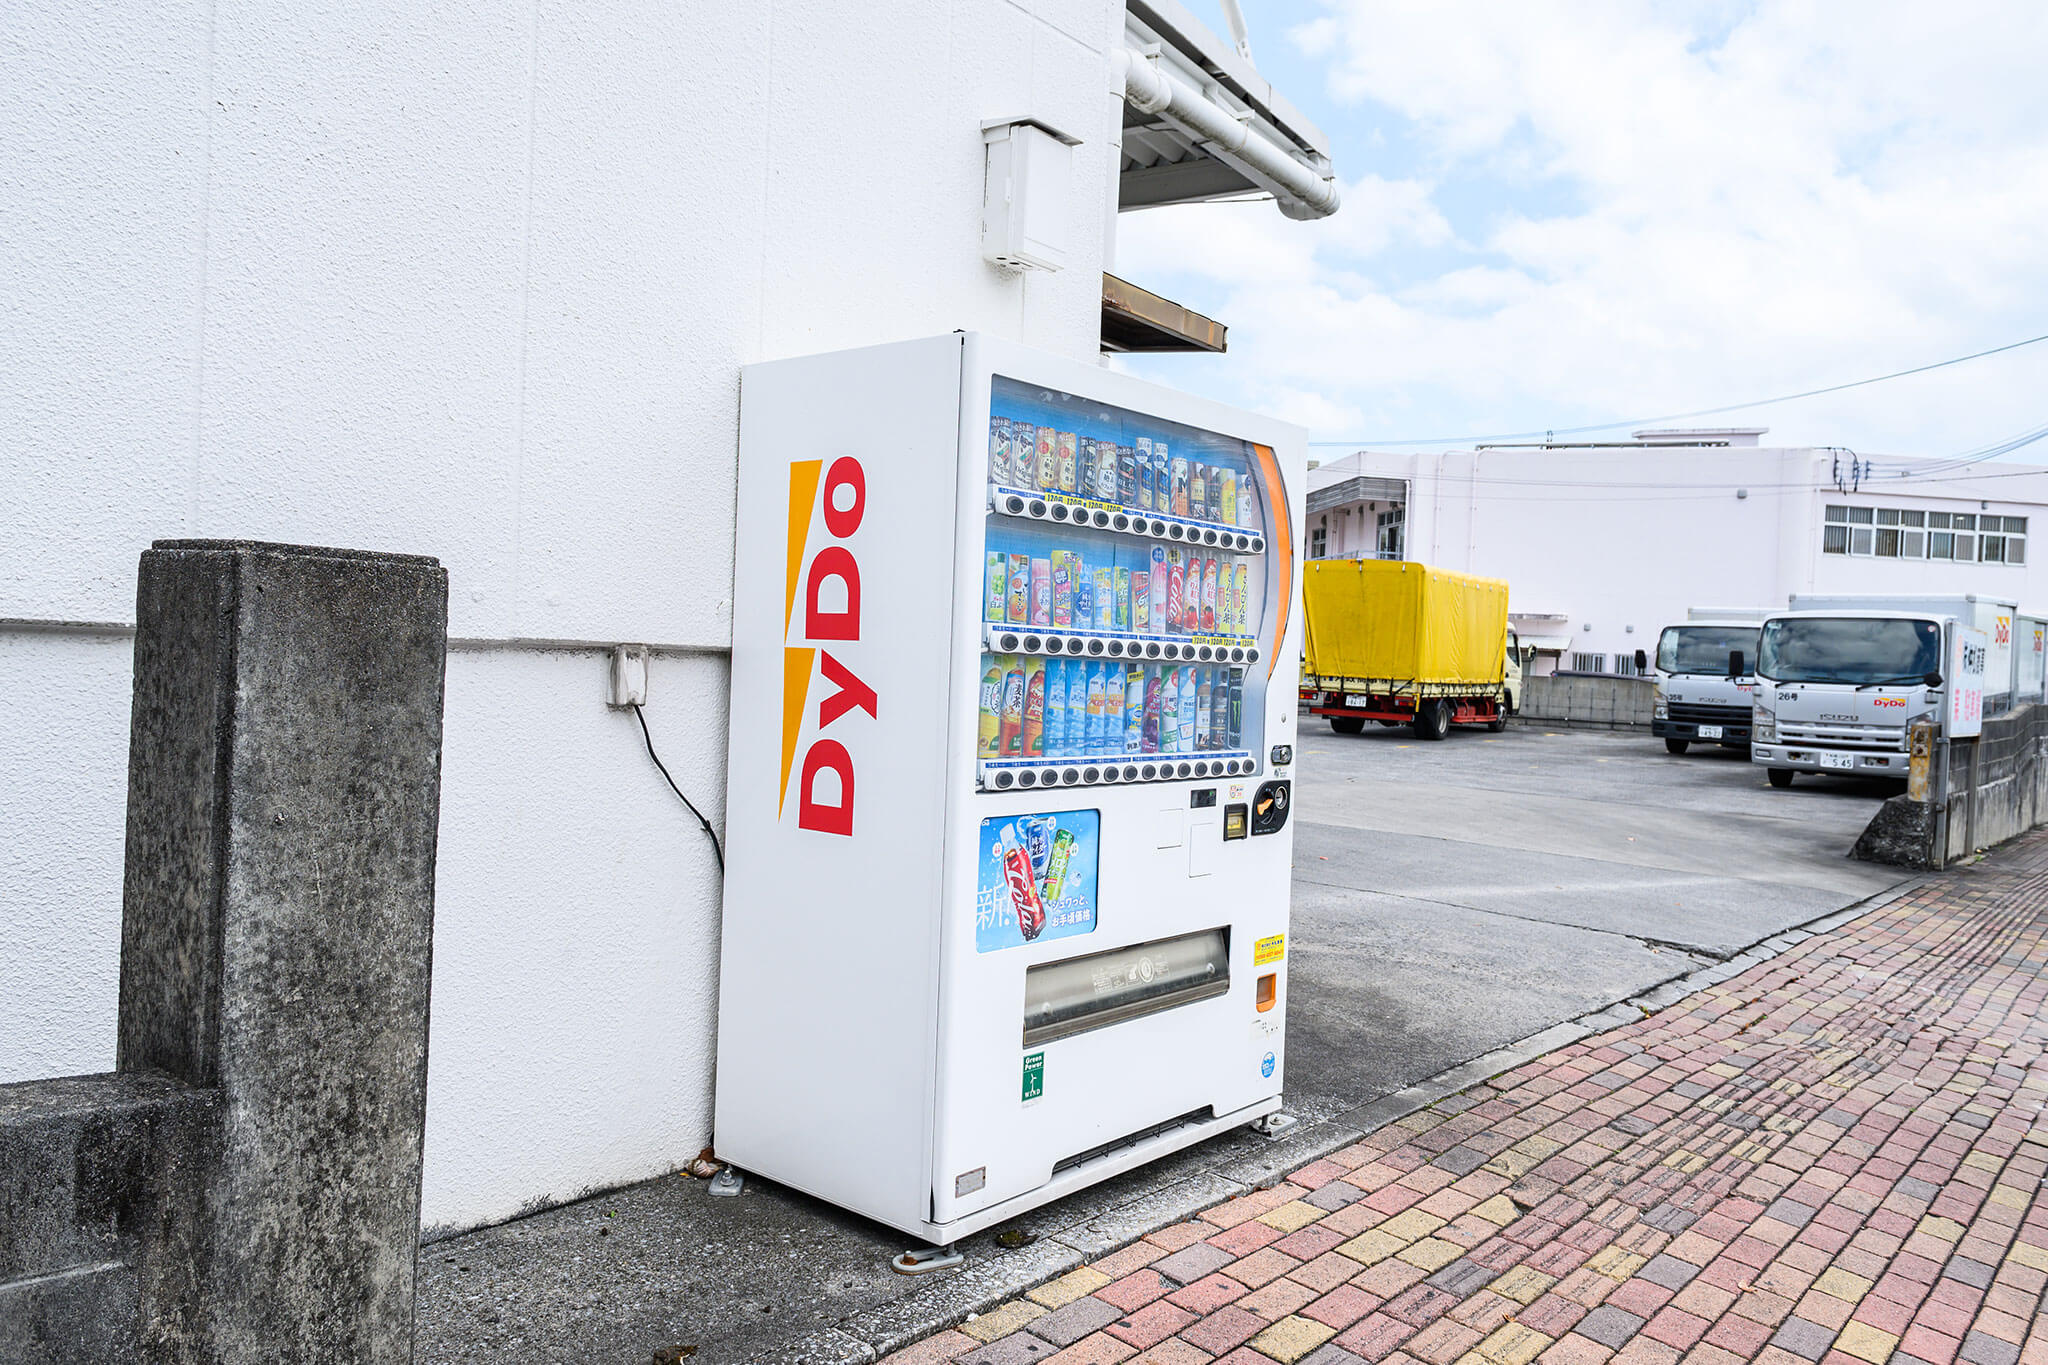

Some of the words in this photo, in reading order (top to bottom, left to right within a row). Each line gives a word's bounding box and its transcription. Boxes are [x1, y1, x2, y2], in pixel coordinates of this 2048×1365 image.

[798, 455, 878, 837] DyDo
[1778, 692, 1798, 702] 26号
[1874, 698, 1906, 708] DyDo
[1819, 713, 1860, 722] ISUZU
[1025, 1056, 1042, 1064] Green
[1024, 1062, 1042, 1071] Power
[1024, 1088, 1041, 1098] WIND
